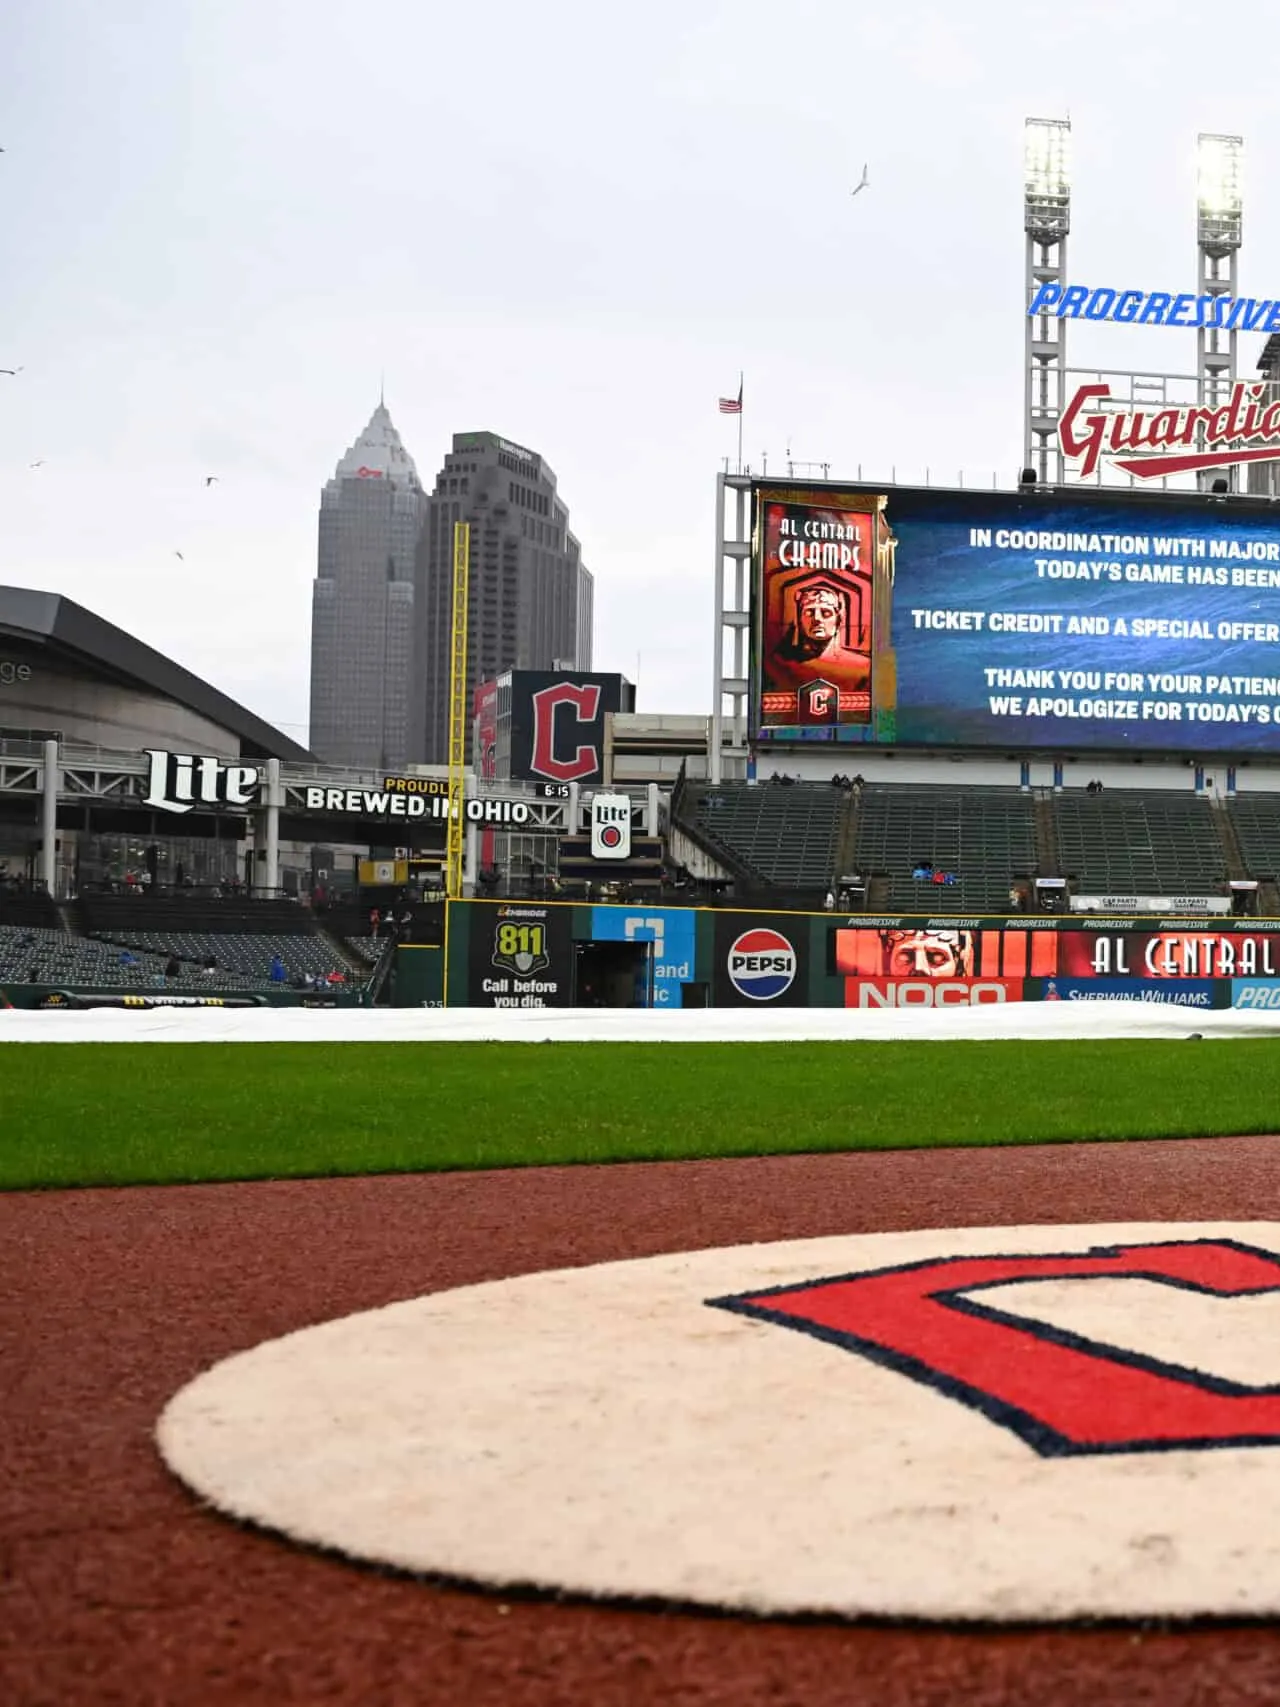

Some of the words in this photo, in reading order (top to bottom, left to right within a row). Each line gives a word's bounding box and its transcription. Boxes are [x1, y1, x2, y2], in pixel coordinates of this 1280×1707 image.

[780, 518, 797, 537] AL
[804, 521, 862, 542] CENTRAL
[779, 540, 860, 572] CHAMPS
[970, 528, 991, 547] IN
[996, 530, 1149, 555] COORDINATION
[1153, 537, 1205, 557] WITH
[1209, 540, 1279, 561] MAJOR
[1035, 559, 1122, 581] TODAY'S
[1126, 563, 1184, 584] GAME
[1188, 567, 1228, 586] HAS
[912, 610, 985, 631] TICKET
[989, 613, 1063, 633] CREDIT
[1067, 616, 1109, 635] AND
[1114, 618, 1128, 636] A
[1132, 618, 1214, 640] SPECIAL
[1218, 622, 1279, 642] OFFER
[984, 668, 1054, 688] THANK
[1059, 671, 1101, 690] YOU
[1105, 672, 1144, 691] FOR
[1148, 674, 1202, 693] YOUR
[989, 696, 1022, 715] WE
[1026, 697, 1139, 720] APOLOGIZE
[1143, 701, 1181, 720] FOR
[1186, 702, 1270, 723] TODAY'S
[530, 682, 601, 782] C
[143, 750, 258, 813] Lite
[385, 778, 457, 796] PROUDLY
[307, 787, 425, 816] BREWED
[433, 798, 459, 819] IN
[467, 800, 528, 823] OHIO
[596, 805, 628, 825] Lite
[928, 919, 982, 927] PROGRESSIVE
[1006, 920, 1060, 928] PROGRESSIVE
[499, 925, 541, 956] 811
[732, 956, 792, 972] PEPSI
[1090, 937, 1130, 974] AL
[1145, 938, 1275, 976] CENTRAL
[483, 979, 508, 993] Call
[514, 979, 557, 993] before
[859, 983, 1006, 1008] NOCO
[494, 997, 519, 1008] you
